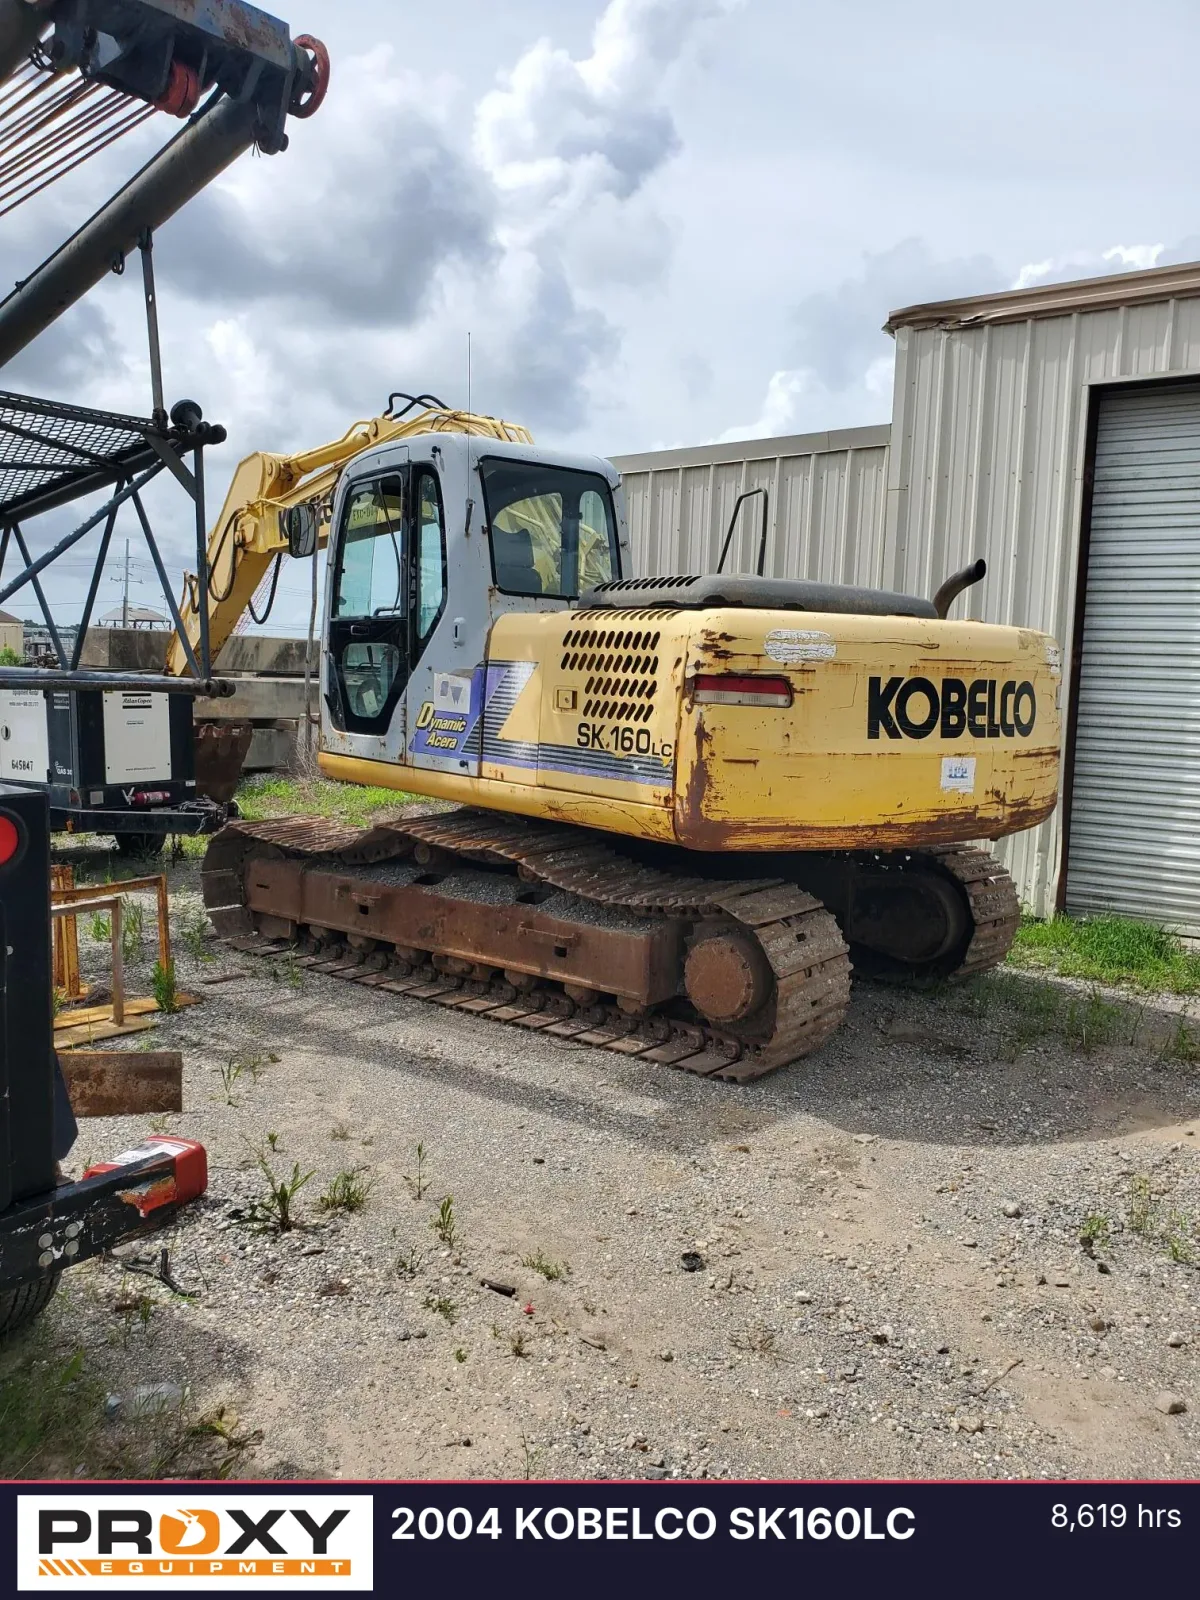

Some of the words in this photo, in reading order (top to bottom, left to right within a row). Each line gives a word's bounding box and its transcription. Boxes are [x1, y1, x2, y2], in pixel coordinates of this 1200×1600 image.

[416, 701, 467, 733] Dynamic
[867, 676, 1036, 740] KOBELCO
[425, 731, 458, 750] Acera
[11, 759, 34, 771] 645847
